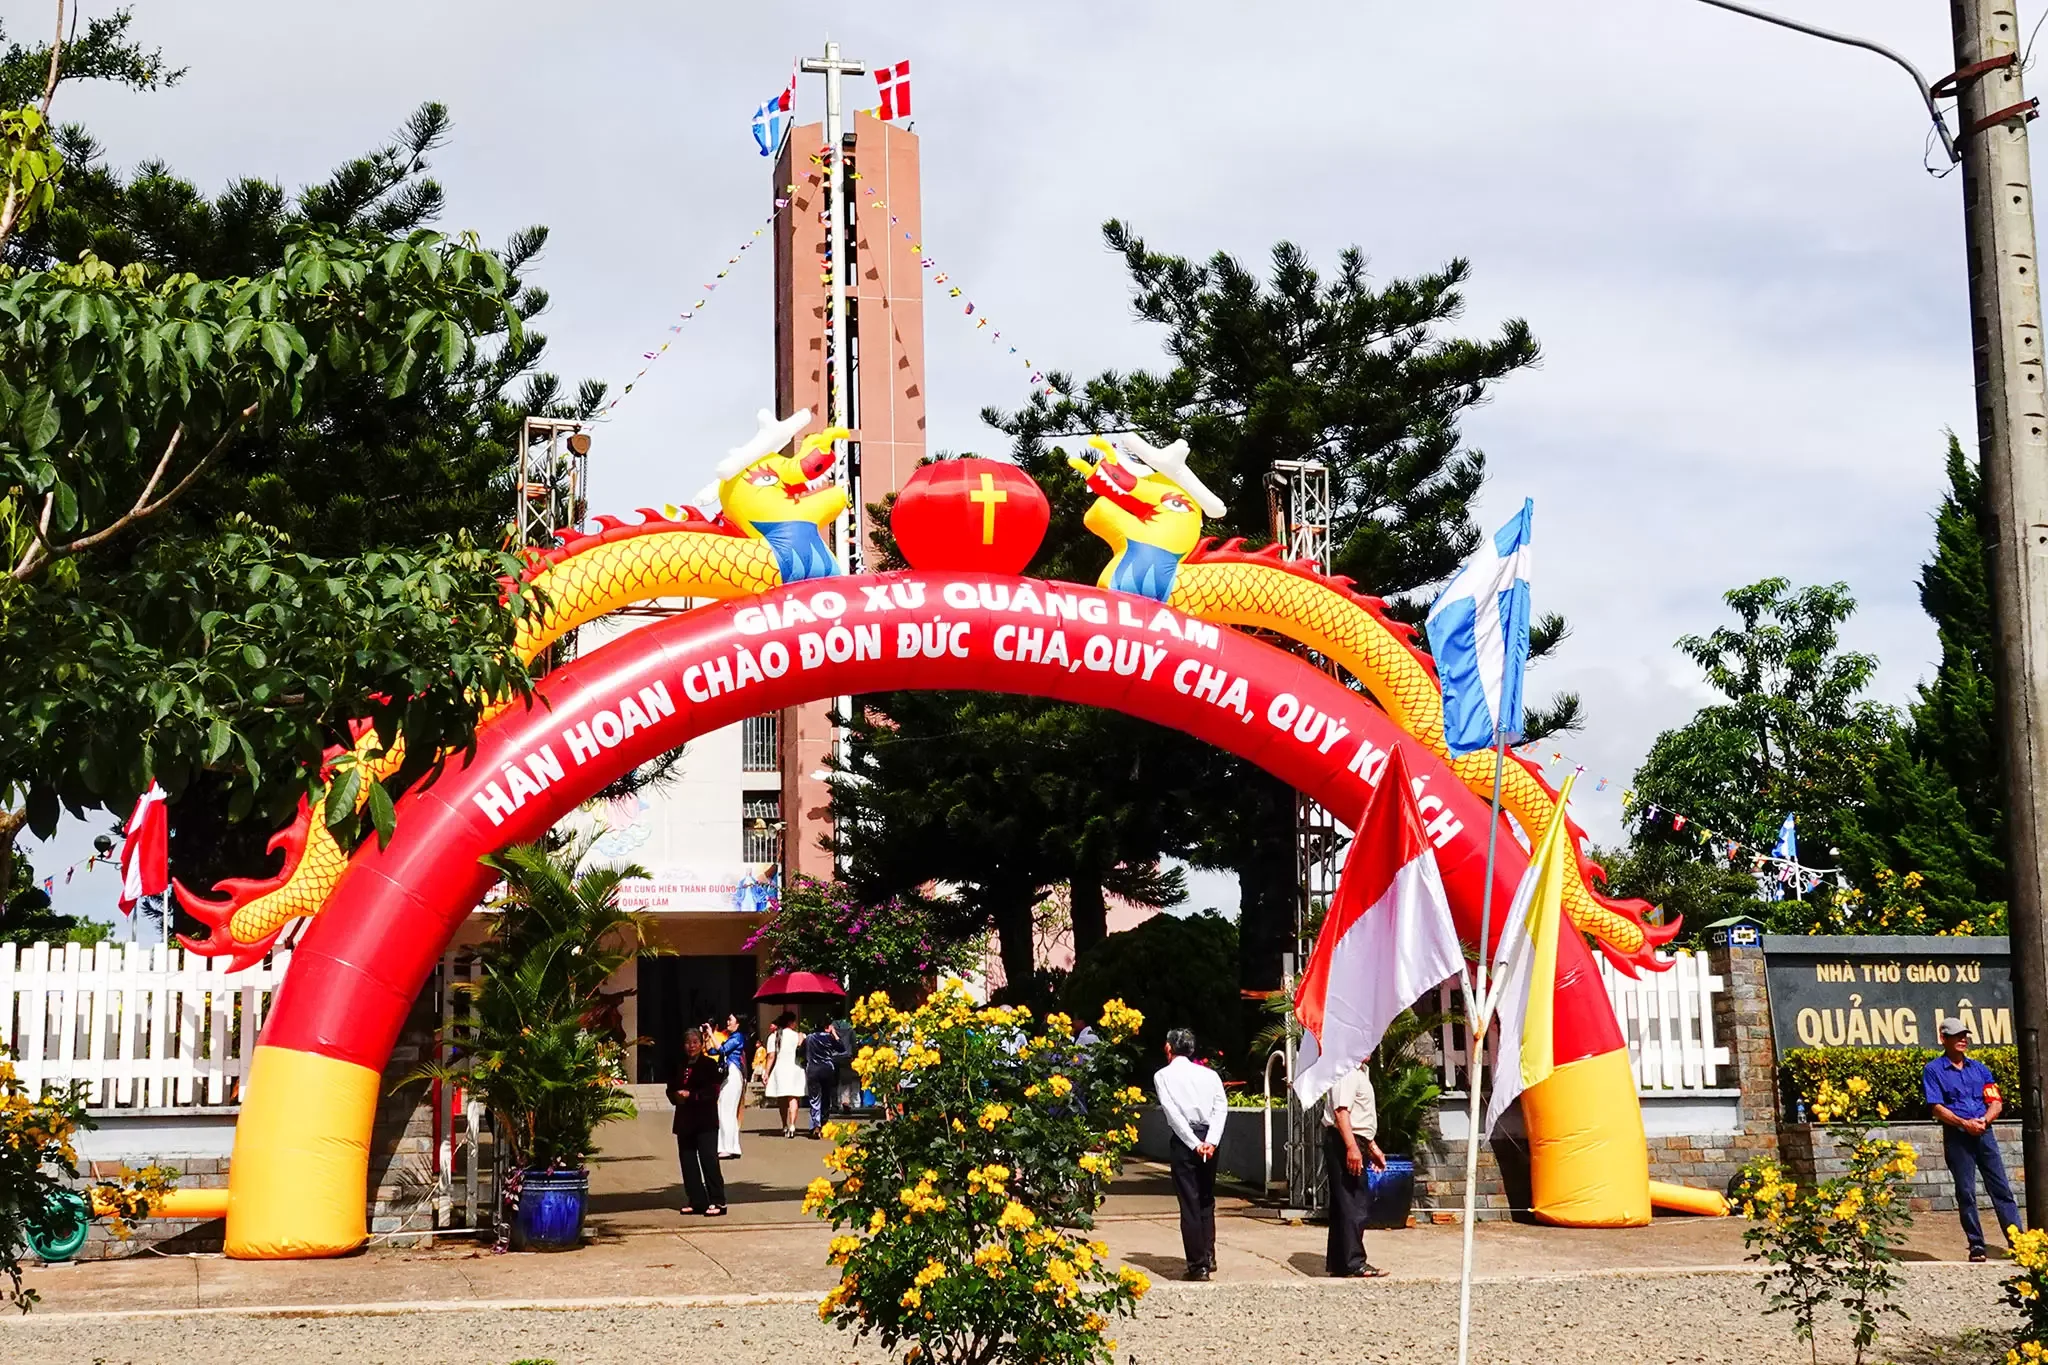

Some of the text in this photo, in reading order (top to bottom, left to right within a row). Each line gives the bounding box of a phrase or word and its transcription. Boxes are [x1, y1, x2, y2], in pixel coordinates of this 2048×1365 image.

[733, 591, 847, 635] GIÁO
[562, 679, 676, 766] HOAN
[682, 640, 790, 704] CHÀO
[798, 617, 882, 670] ĐÓN
[896, 614, 971, 659] ĐỨC
[1172, 658, 1254, 724] CHA,
[1266, 692, 1351, 755] QUÝ
[1816, 959, 1982, 983] NHÀ THỜ GIÁO XỨ
[1796, 993, 1919, 1048] QUẢNG
